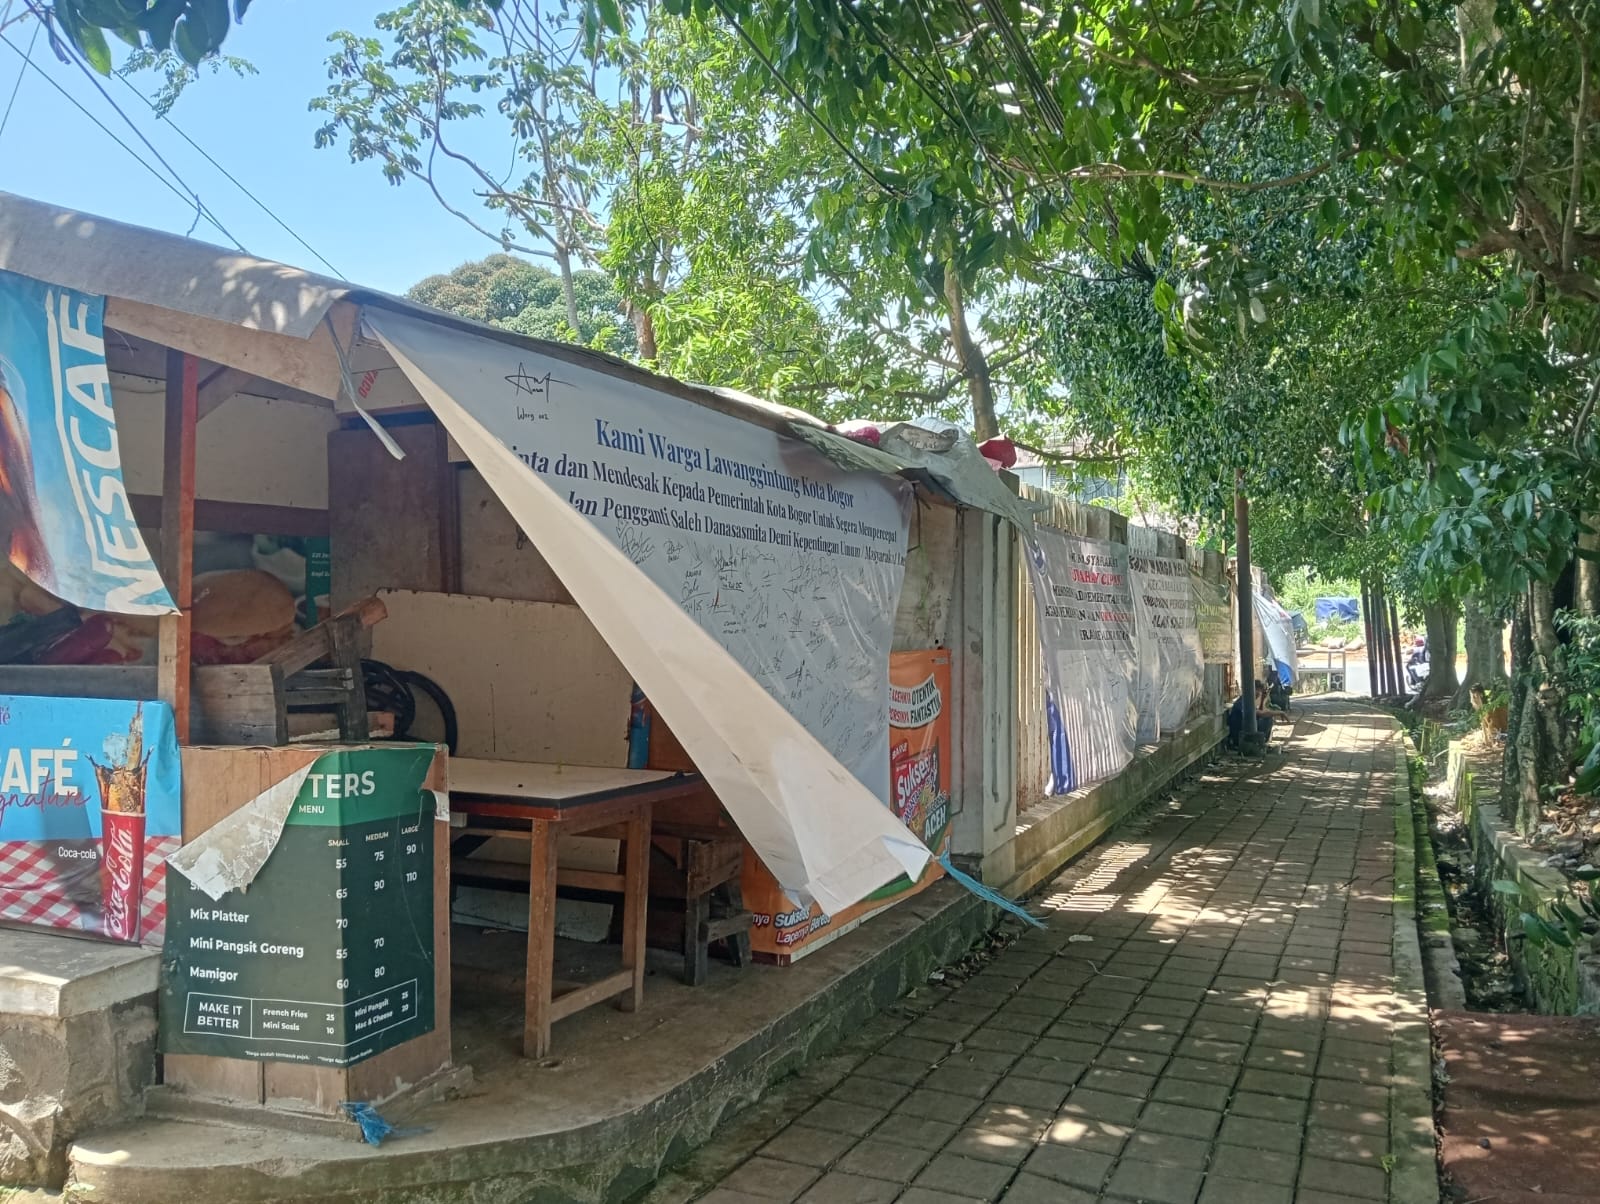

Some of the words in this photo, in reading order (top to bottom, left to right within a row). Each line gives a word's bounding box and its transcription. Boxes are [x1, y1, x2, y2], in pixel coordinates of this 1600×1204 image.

[45, 288, 168, 615] NESCAF
[595, 418, 646, 456] Kami
[648, 432, 702, 472] Warga
[705, 448, 801, 498] Lawanggintung
[801, 476, 825, 500] Kota
[827, 482, 854, 510] Bogor
[512, 445, 549, 473] nta
[555, 453, 588, 479] dan
[592, 460, 660, 493] Mendesak
[662, 476, 705, 502] Kepada
[707, 486, 765, 514] Pemerintah
[767, 499, 786, 519] Kota
[788, 505, 812, 526] Bogor
[813, 510, 835, 528] Untuk
[835, 516, 858, 535] Segera
[602, 497, 670, 526] Pengganti
[671, 509, 702, 533] Saleh
[705, 516, 767, 543] Danasasmita
[769, 526, 792, 547] Demi
[793, 531, 840, 556] Kepentingan
[0, 738, 78, 797] AFÉ
[307, 770, 376, 799] TERS
[299, 805, 325, 814] MENU
[401, 825, 419, 835] LARGE
[925, 804, 946, 841] ACEH
[328, 839, 350, 847] SMALL
[365, 831, 389, 842] MEDIUM
[58, 846, 97, 860] Coca-cola
[335, 858, 347, 869] 55
[374, 850, 384, 862] 75
[406, 844, 417, 855] 90
[335, 888, 348, 899] 65
[374, 879, 385, 891] 90
[406, 871, 418, 883] 110
[190, 908, 209, 920] Mix
[212, 910, 249, 923] Platter
[336, 918, 348, 929] 70
[190, 936, 213, 950] Mini
[216, 939, 257, 955] Pangsit
[260, 943, 304, 958] Goreng
[336, 948, 348, 959] 55
[374, 937, 385, 949] 70
[190, 966, 238, 982] Mamigor
[336, 979, 350, 990] 60
[374, 966, 386, 978] 80
[199, 1002, 229, 1015] MAKE
[232, 1005, 243, 1016] IT
[263, 1008, 289, 1018] French
[290, 1009, 308, 1019] Fries
[197, 1015, 240, 1029] BETTER
[263, 1021, 280, 1030] Mini
[281, 1022, 300, 1031] Sosis
[326, 1026, 335, 1035] 10
